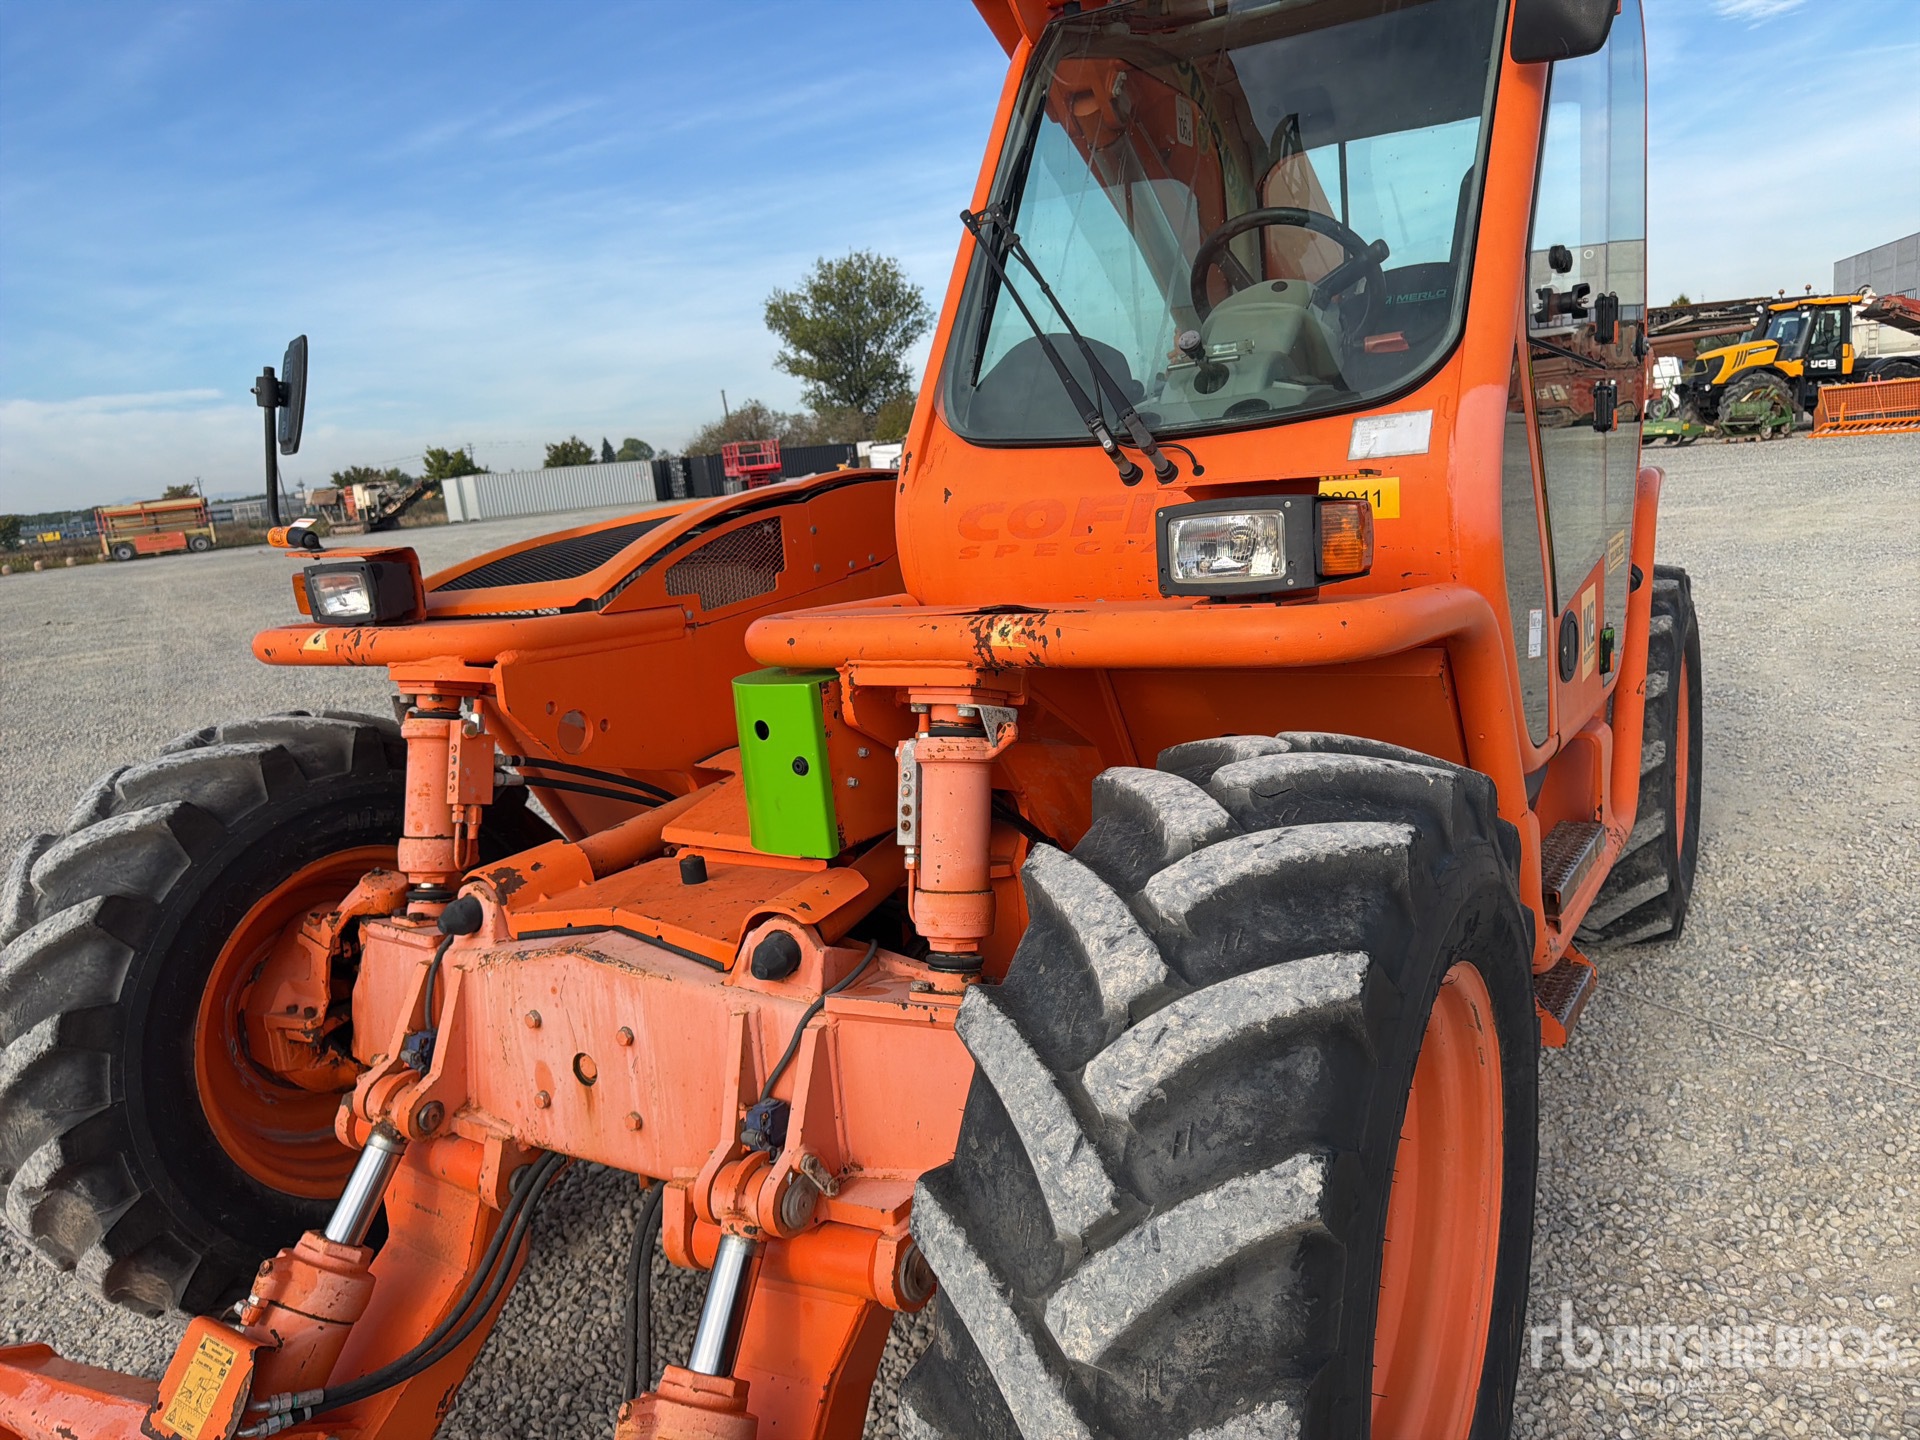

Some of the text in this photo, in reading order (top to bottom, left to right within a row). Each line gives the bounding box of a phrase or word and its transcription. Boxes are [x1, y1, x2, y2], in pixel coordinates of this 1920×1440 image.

[1397, 289, 1447, 303] MERLO
[1811, 359, 1836, 368] JCB
[958, 493, 1165, 541] COFI
